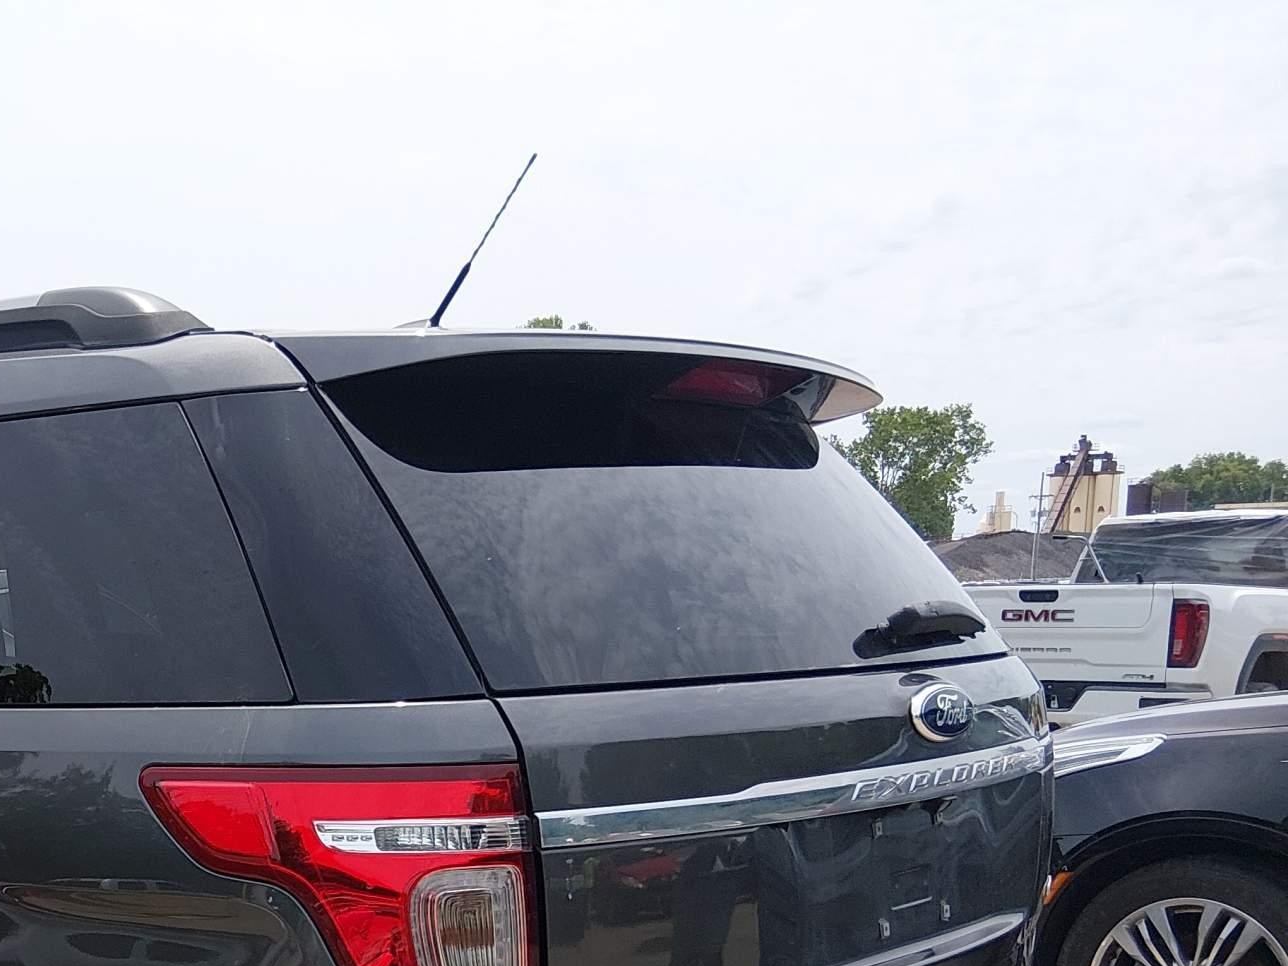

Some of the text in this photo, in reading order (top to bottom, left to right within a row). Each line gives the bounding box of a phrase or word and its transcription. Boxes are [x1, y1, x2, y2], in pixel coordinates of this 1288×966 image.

[1001, 609, 1075, 622] GMC
[936, 694, 969, 727] Ford
[851, 754, 1020, 801] EXPLORER
